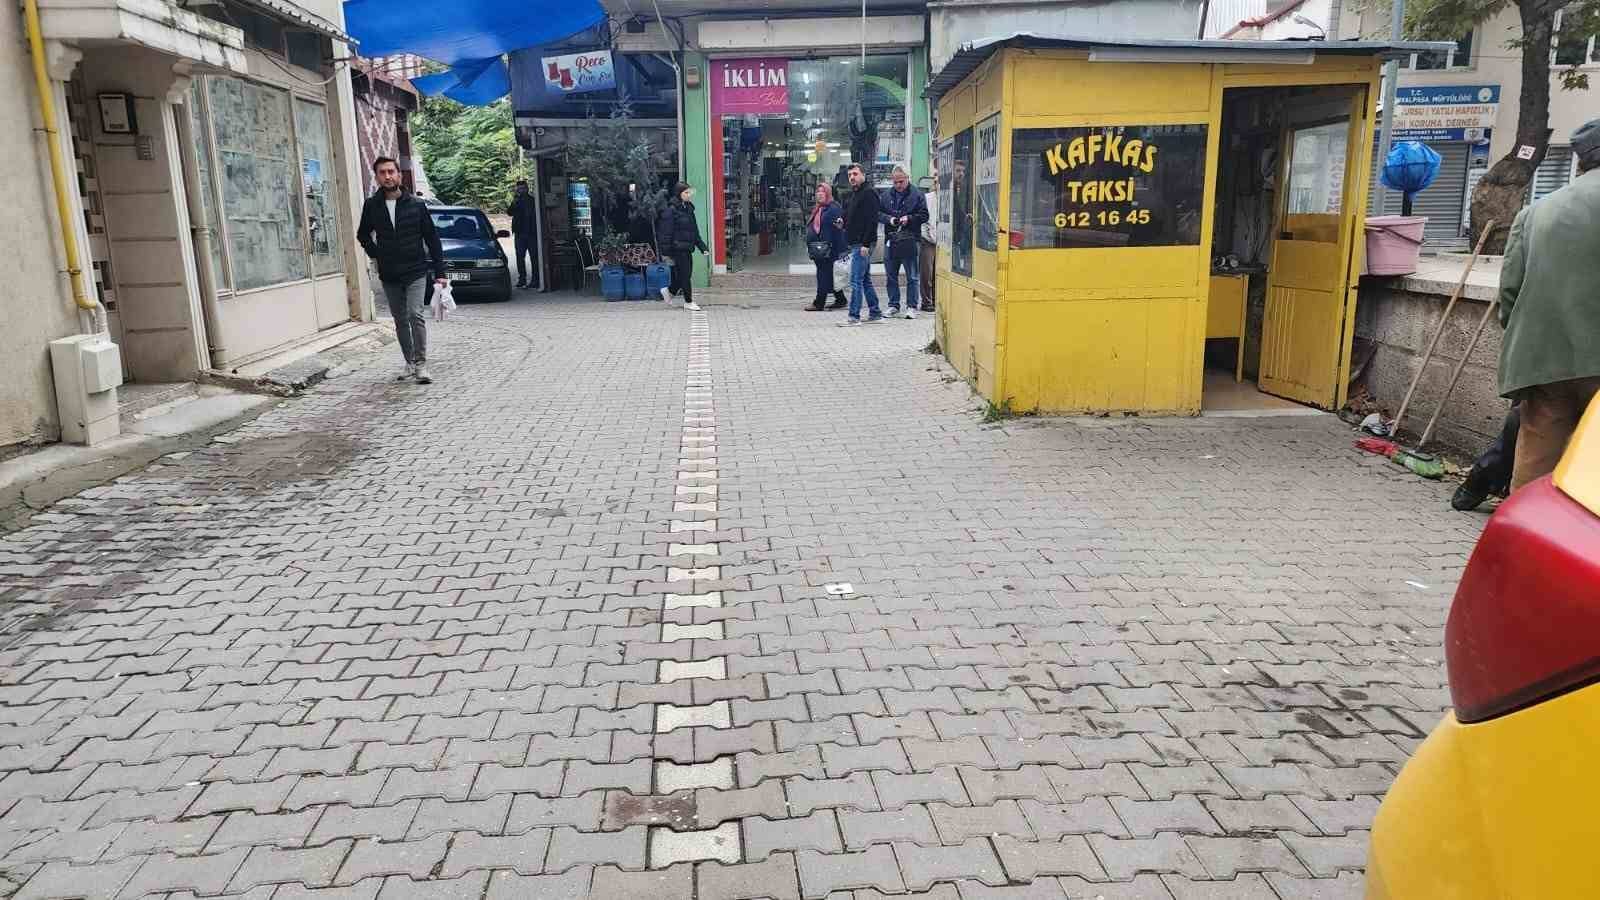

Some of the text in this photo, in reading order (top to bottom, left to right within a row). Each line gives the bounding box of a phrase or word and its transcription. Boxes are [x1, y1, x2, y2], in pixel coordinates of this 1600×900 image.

[723, 63, 787, 88] İKLİM
[1046, 131, 1158, 176] KAFKAS
[1067, 176, 1135, 204] TAKSİ
[1054, 209, 1151, 228] 612 16 45
